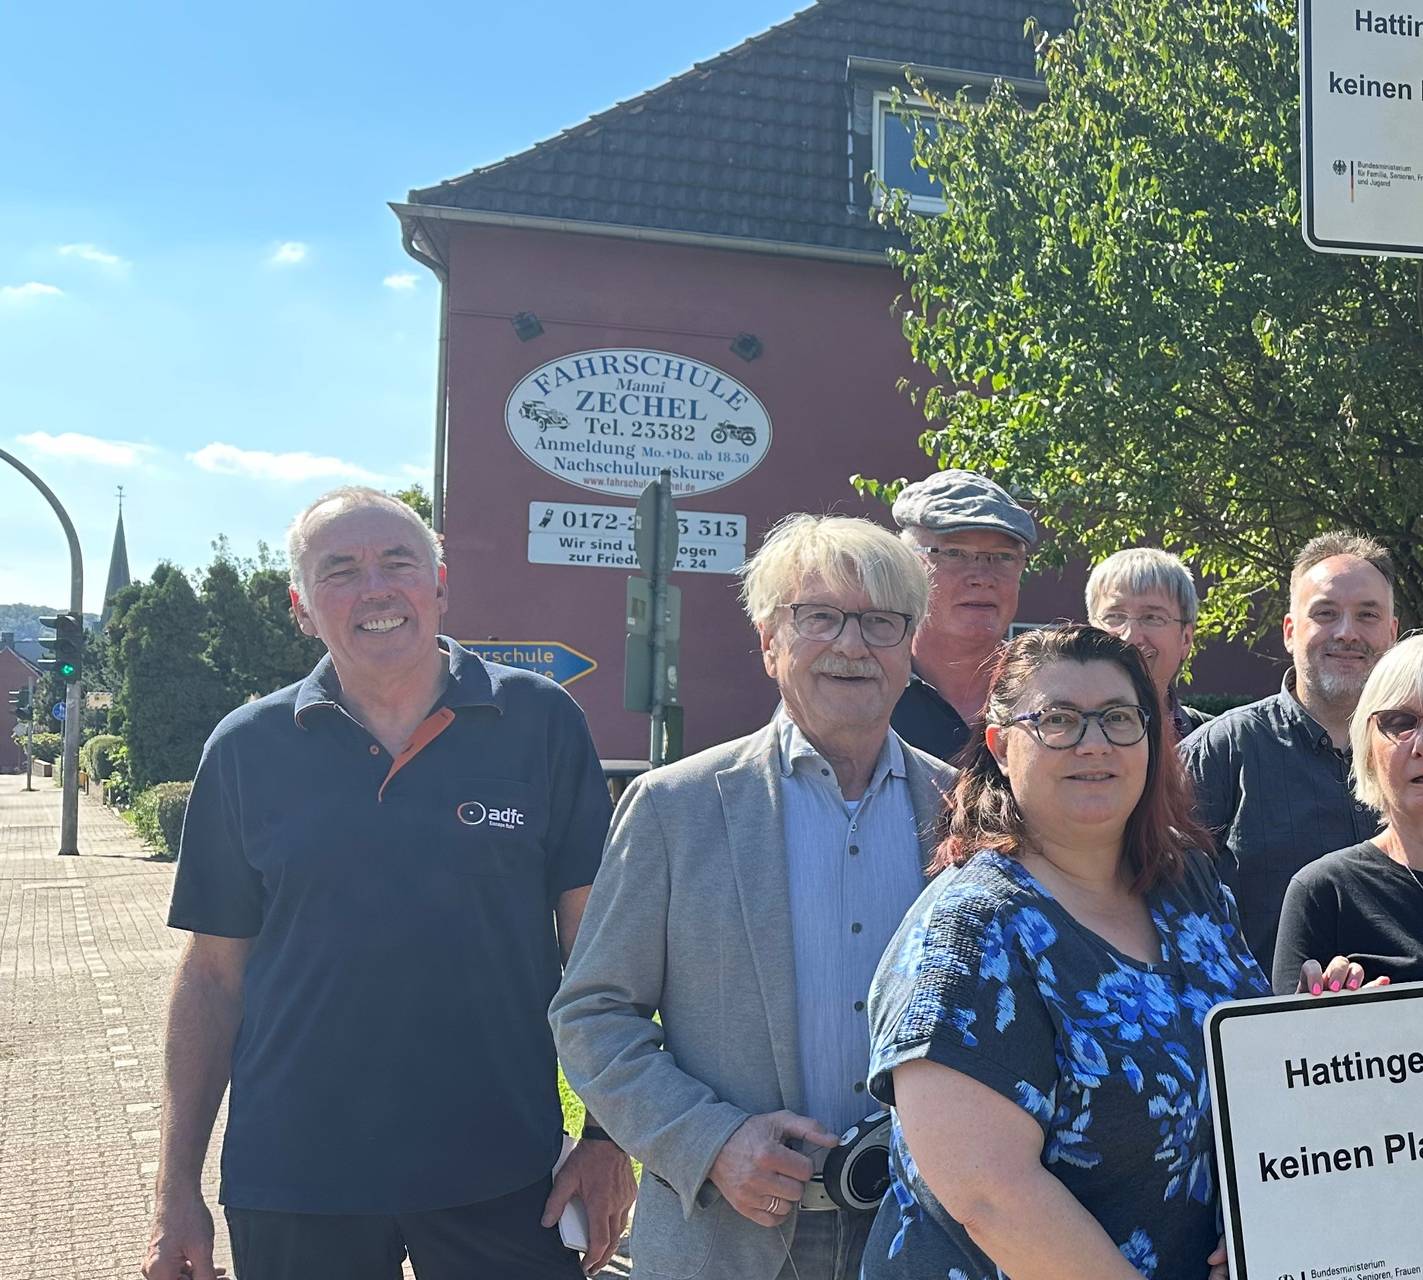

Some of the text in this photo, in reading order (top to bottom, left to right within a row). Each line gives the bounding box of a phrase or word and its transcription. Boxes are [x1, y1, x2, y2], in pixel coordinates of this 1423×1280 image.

[1328, 71, 1413, 101] keinen
[530, 354, 749, 412] FAHRSCHULE
[616, 378, 666, 395] Manni
[575, 390, 708, 422] ZECHEL
[584, 417, 696, 442] Tel. 23382
[534, 436, 636, 460] Anmeldung
[641, 446, 694, 460] Mo.+Do.
[697, 451, 713, 462] ab
[553, 456, 725, 481] Nachschulunskurse
[698, 520, 738, 538] 313
[559, 537, 586, 550] Wir
[590, 539, 622, 551] sind
[568, 553, 592, 563] zur
[690, 559, 707, 569] 24
[488, 807, 524, 825] adfc
[1259, 1144, 1374, 1183] keinen
[1310, 1260, 1386, 1279] Bundesministerium
[1395, 1266, 1421, 1277] Frauen
